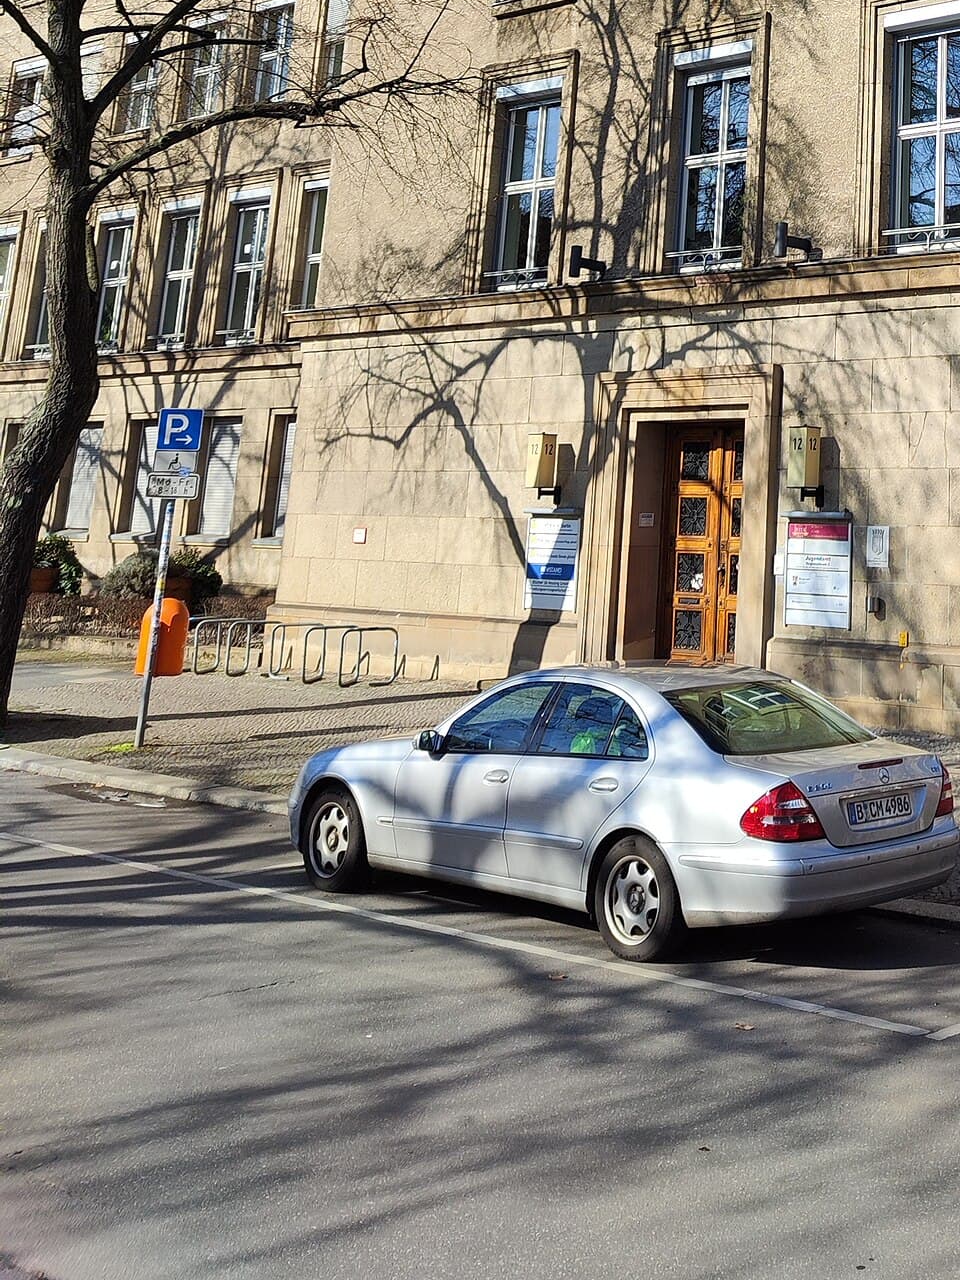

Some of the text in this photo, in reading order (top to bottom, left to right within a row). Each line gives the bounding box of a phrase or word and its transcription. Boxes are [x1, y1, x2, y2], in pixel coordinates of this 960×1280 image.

[163, 414, 189, 445] P
[531, 443, 539, 455] 12
[545, 443, 554, 455] 12
[793, 437, 803, 450] 12
[809, 437, 817, 450] 12
[856, 803, 865, 820] B
[885, 796, 910, 816] 4986
